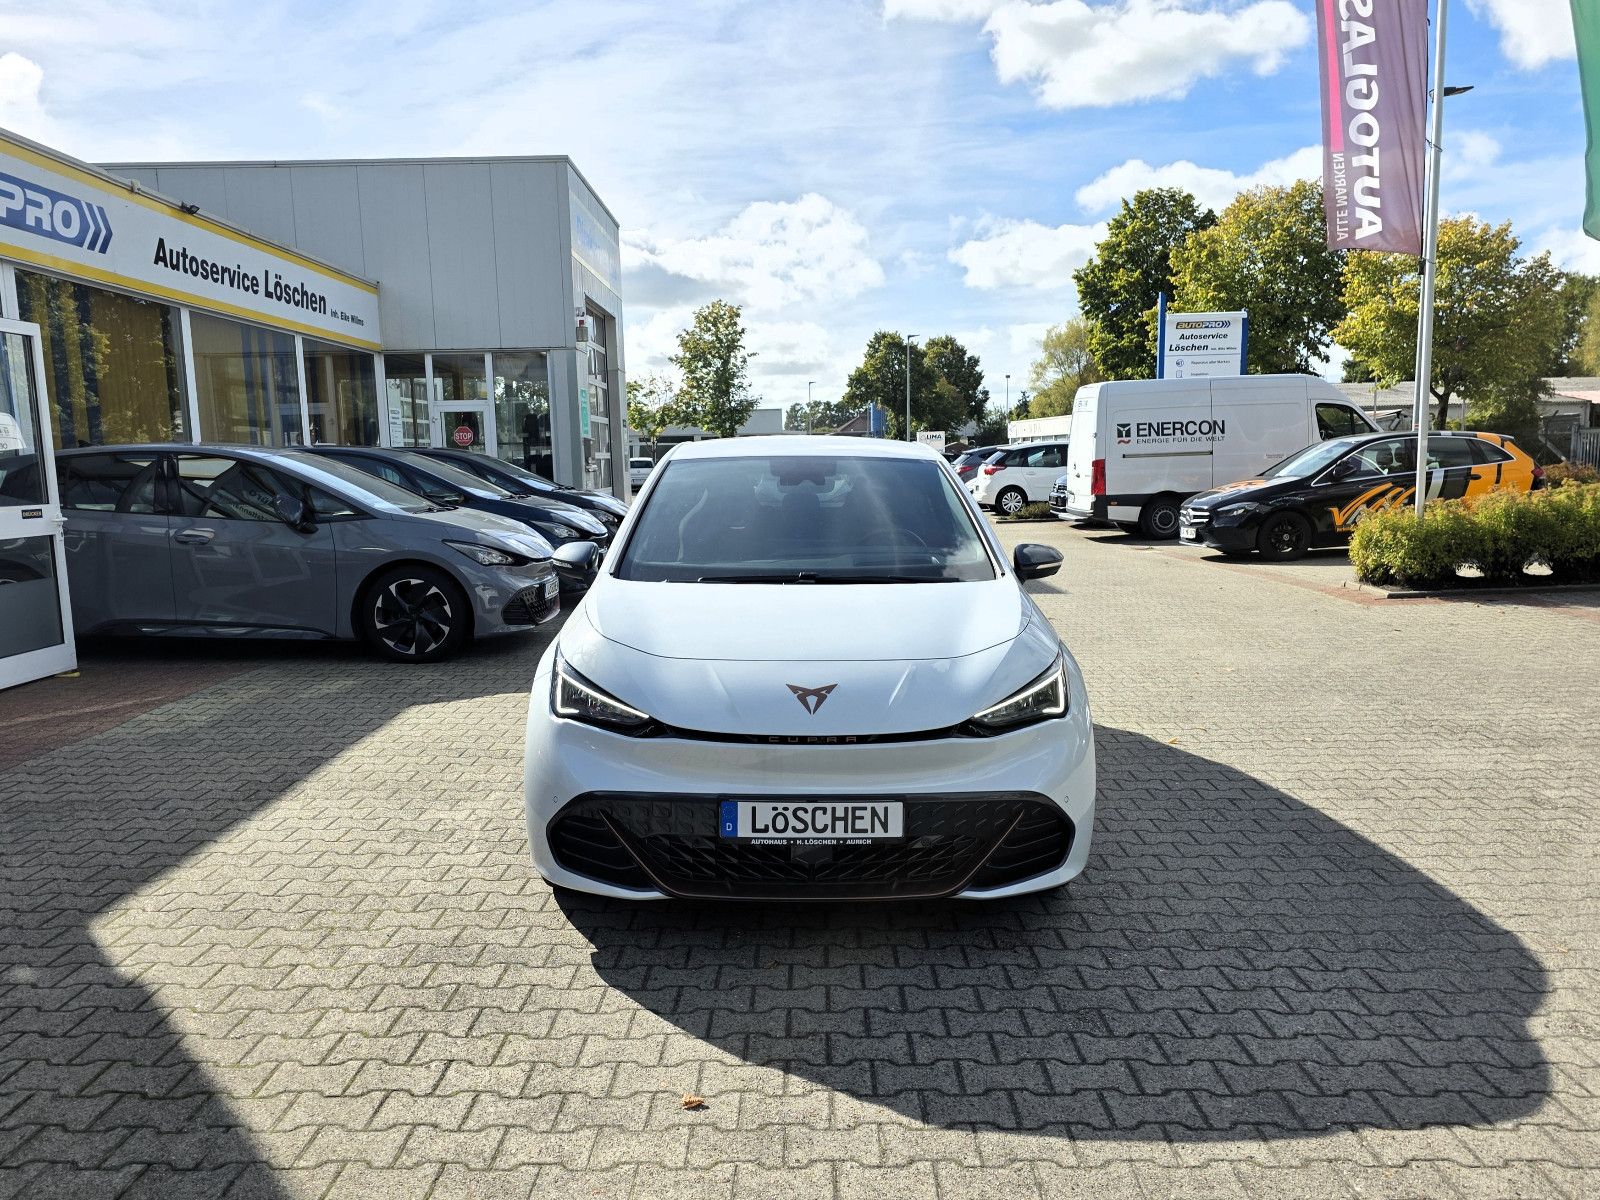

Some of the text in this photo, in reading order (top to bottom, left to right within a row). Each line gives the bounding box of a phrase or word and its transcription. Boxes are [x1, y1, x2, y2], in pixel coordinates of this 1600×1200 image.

[0, 181, 80, 239] PRO
[153, 237, 260, 295] Autoservice
[264, 269, 327, 315] Löschen
[1179, 332, 1229, 341] Autoservice
[1168, 343, 1209, 352] Löschen
[455, 432, 472, 440] STOP
[1136, 420, 1226, 438] ENERCON
[726, 805, 889, 834] D LÖSCHEN
